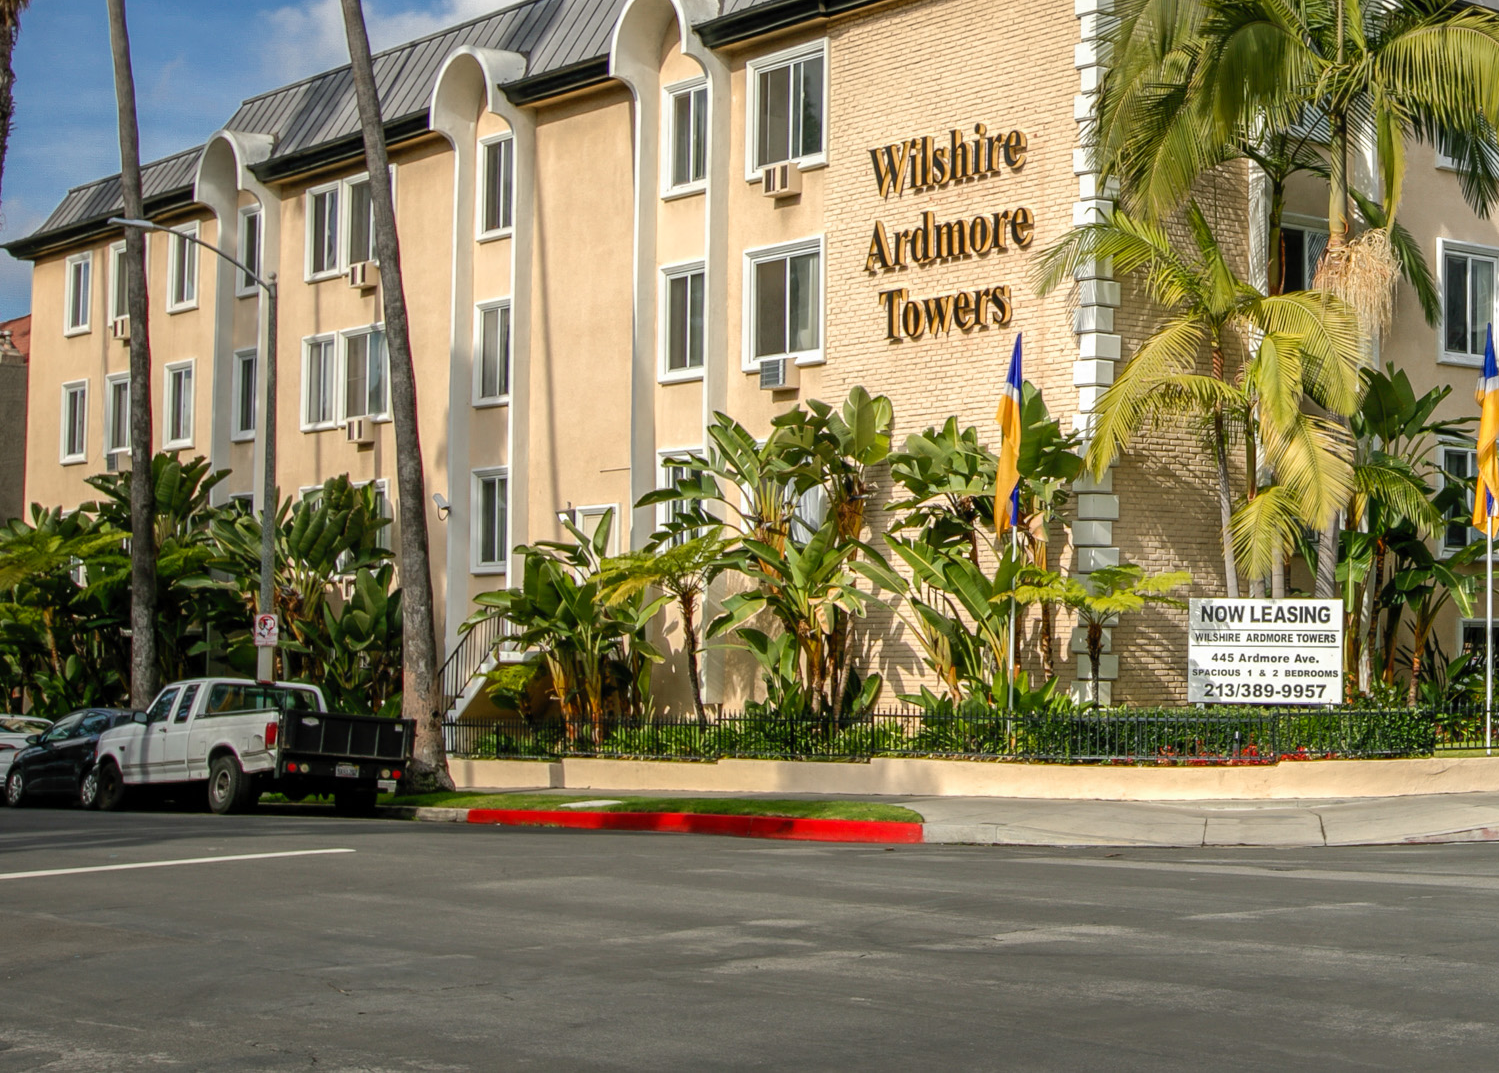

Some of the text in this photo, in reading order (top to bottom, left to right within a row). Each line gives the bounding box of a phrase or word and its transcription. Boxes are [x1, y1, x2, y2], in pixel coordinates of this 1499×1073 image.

[868, 123, 1028, 198] Wilshire
[863, 207, 1034, 272] Ardmore
[878, 285, 1013, 339] Towers
[1201, 605, 1331, 624] NOW LEASING
[1195, 633, 1336, 643] WILSHIRE ARDMORE TOWERS
[1212, 653, 1320, 664] 445 Ardmore Ave.
[1192, 669, 1339, 678] SPACIOUS 1 & 2 BEDROOMS
[1204, 683, 1327, 699] 213/389-9957
